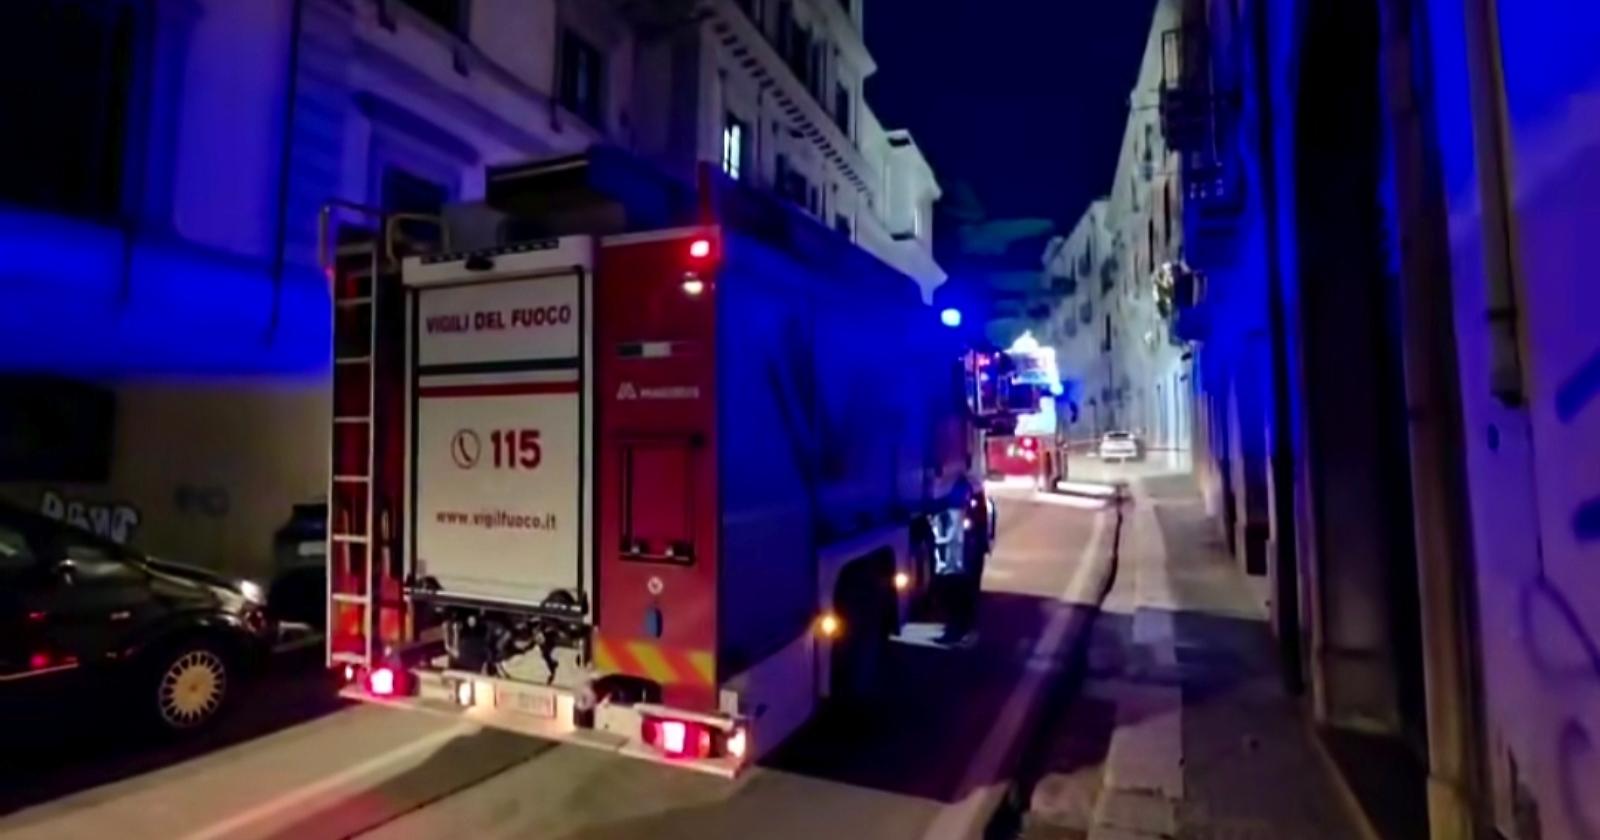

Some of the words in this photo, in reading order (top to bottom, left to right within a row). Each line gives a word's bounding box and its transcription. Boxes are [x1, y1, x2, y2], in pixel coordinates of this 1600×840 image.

[426, 313, 469, 334] VIGILI
[474, 311, 505, 331] DEL
[511, 304, 572, 328] FUOCO
[490, 429, 541, 469] 115
[436, 510, 556, 531] www.vigilfuoco.it
